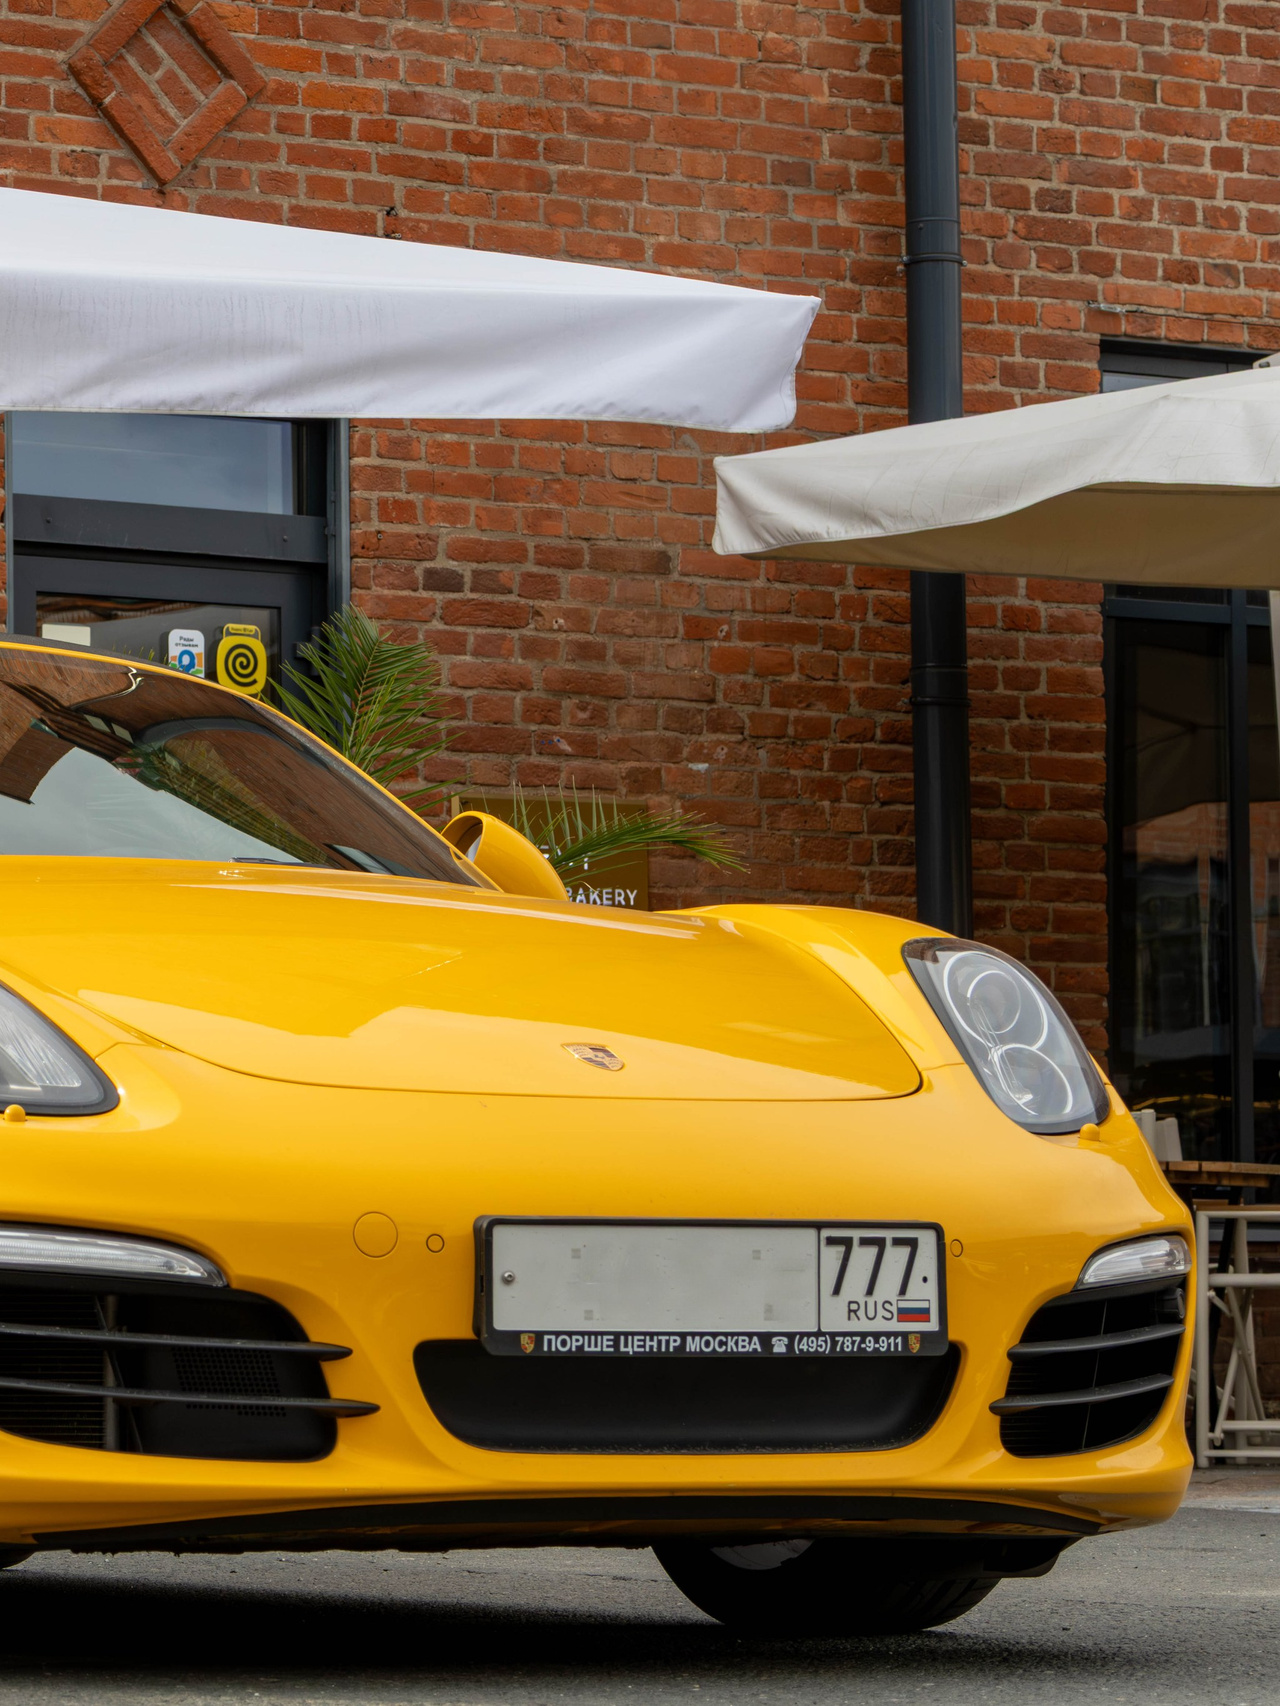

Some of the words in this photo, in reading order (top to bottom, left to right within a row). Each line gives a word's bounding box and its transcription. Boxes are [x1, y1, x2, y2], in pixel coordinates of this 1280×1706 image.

[825, 1236, 919, 1297] 777
[847, 1300, 894, 1321] RUS
[543, 1335, 614, 1352] ПОРШЕ
[620, 1336, 681, 1355] ЦЕНТР
[686, 1336, 762, 1352] МОСКВА
[794, 1334, 831, 1354] (495)
[835, 1336, 902, 1352] 787-9-911
